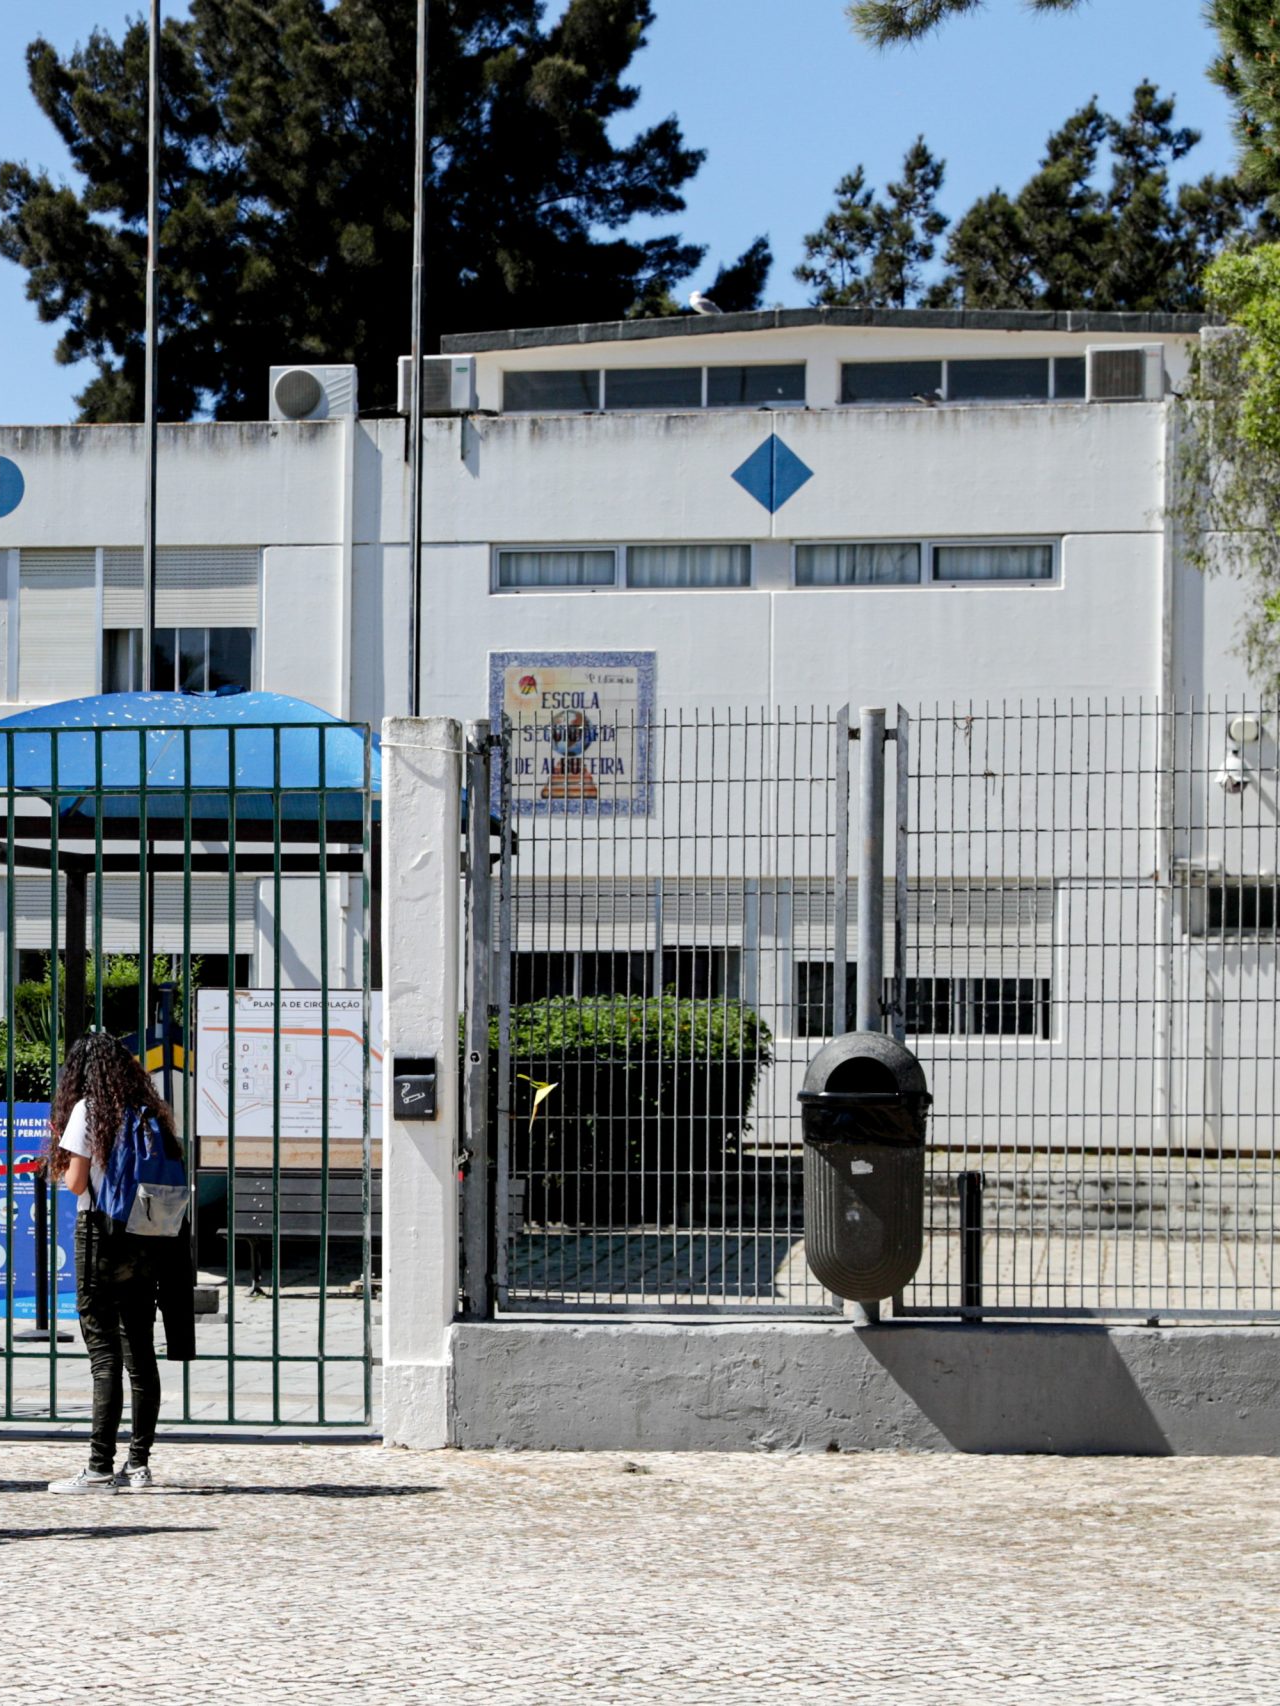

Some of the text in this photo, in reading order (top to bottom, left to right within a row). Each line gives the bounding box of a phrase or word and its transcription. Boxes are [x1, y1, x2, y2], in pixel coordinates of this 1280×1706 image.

[541, 692, 600, 710] ESCOLA
[514, 757, 534, 775] DE
[304, 1000, 360, 1010] CIRCLAÇÃO
[242, 1043, 250, 1052] D
